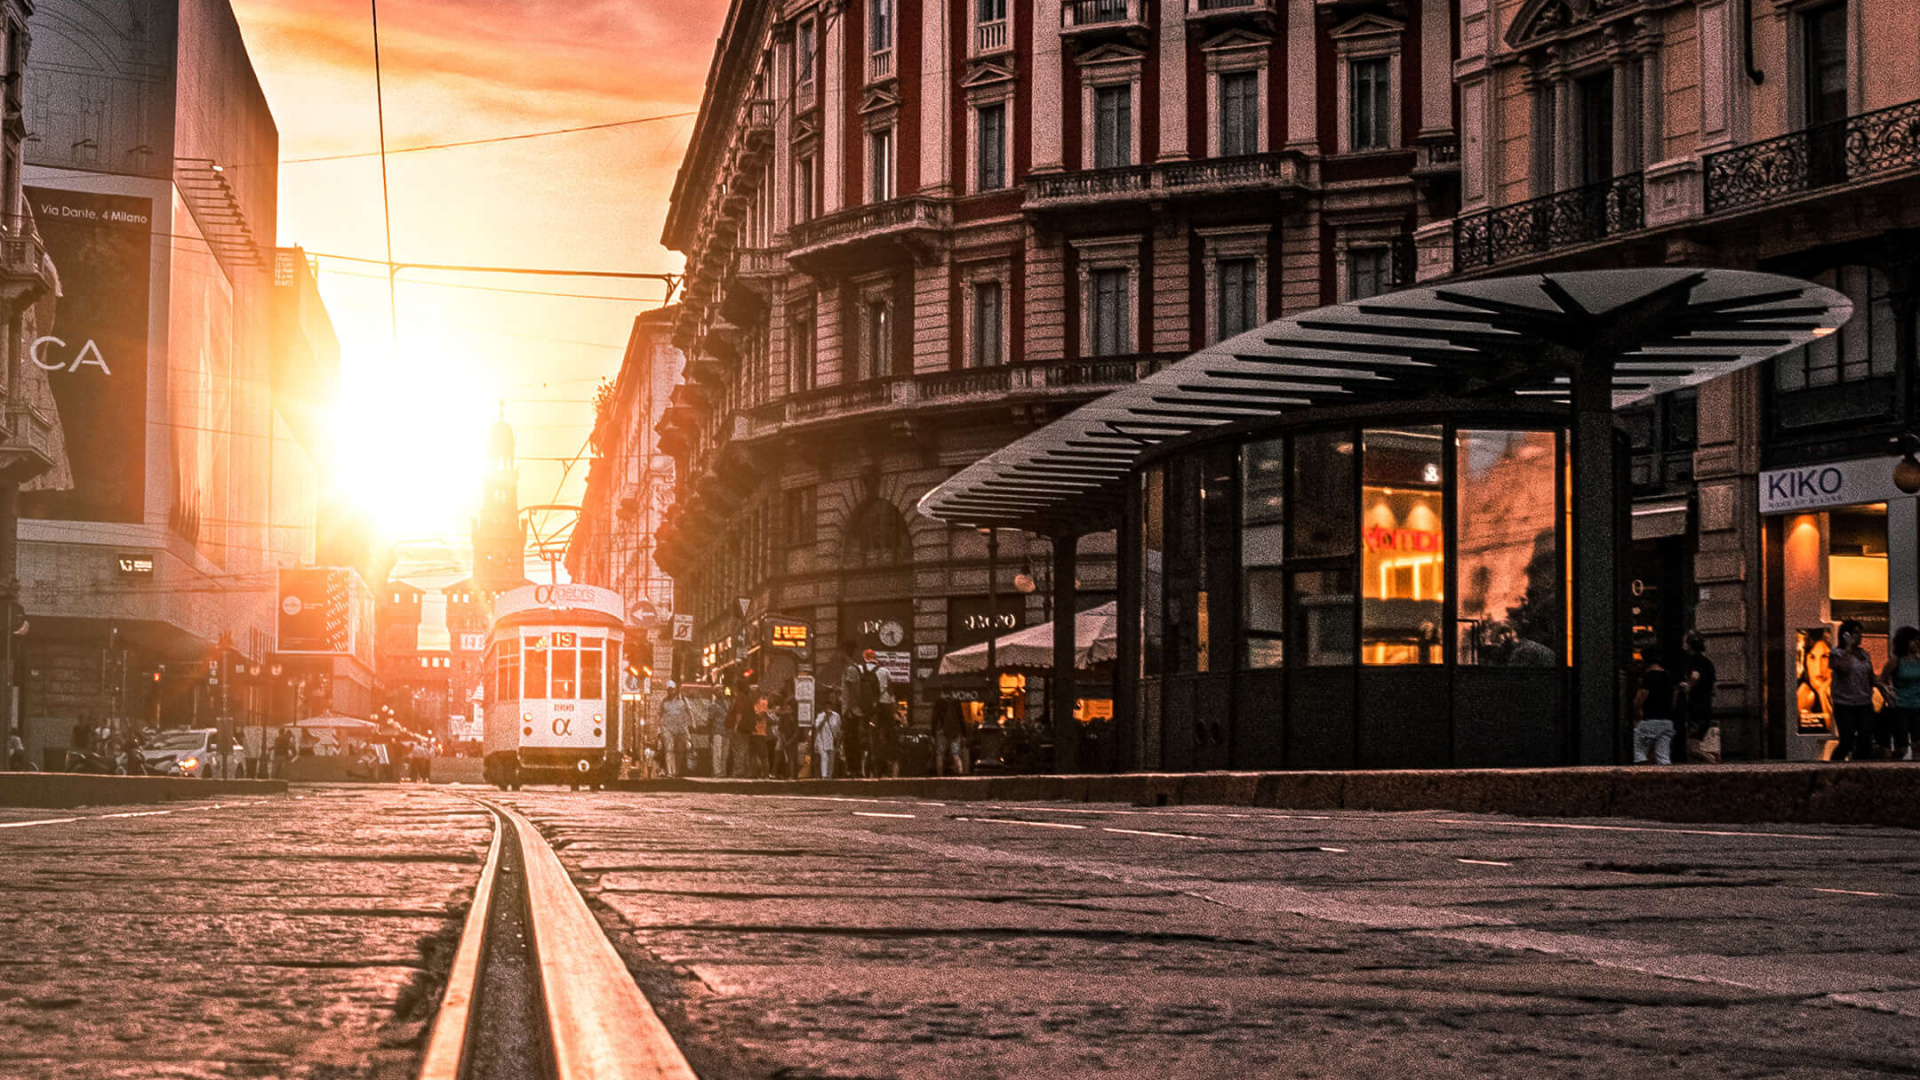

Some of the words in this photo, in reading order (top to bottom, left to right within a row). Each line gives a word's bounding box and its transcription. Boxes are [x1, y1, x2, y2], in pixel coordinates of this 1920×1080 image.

[41, 204, 59, 216] Via
[62, 205, 98, 220] Dante,
[102, 210, 109, 220] 4
[111, 210, 148, 224] Milano
[30, 335, 112, 375] CA
[1768, 467, 1842, 500] KIKO
[556, 632, 572, 648] 19
